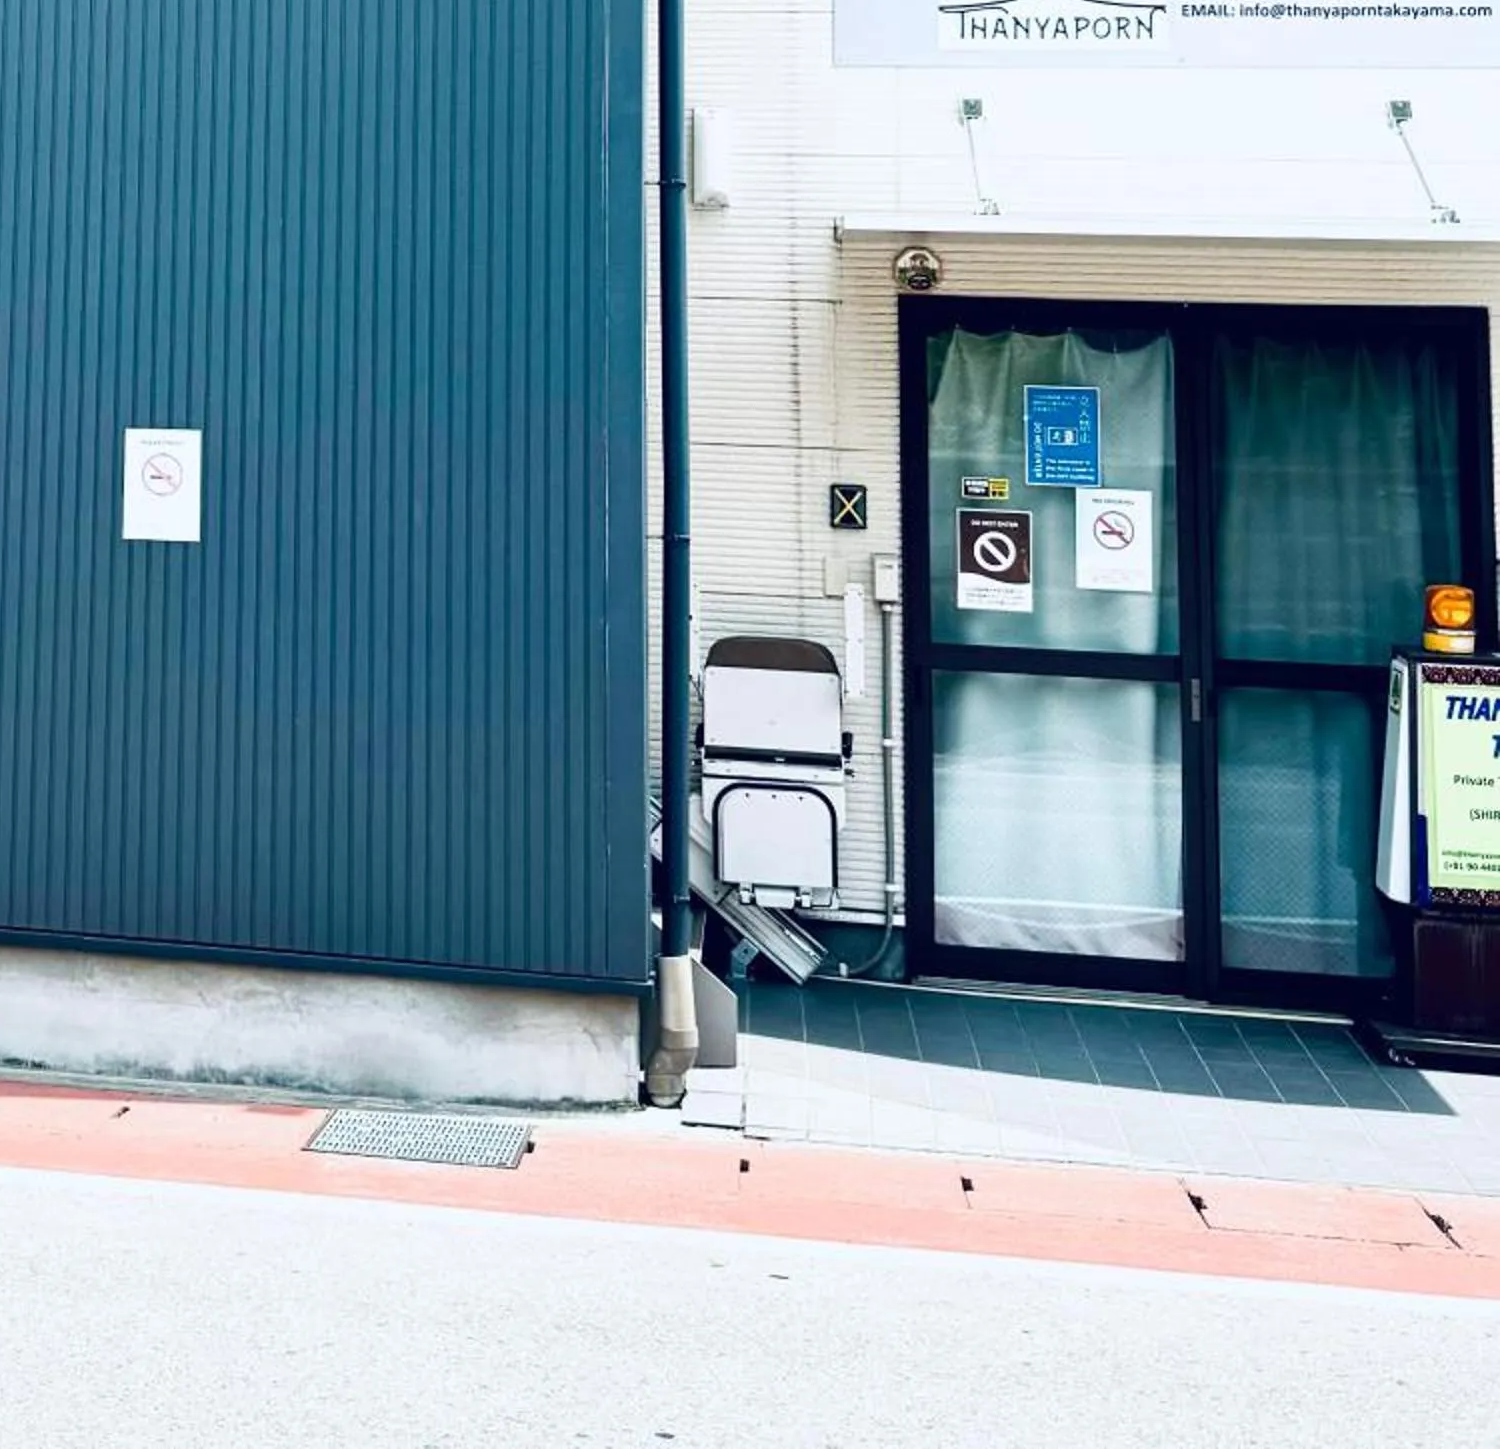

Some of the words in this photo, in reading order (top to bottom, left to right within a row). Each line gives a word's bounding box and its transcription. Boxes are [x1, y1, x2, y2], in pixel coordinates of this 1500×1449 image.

[1180, 4, 1235, 19] EMAIL:
[1238, 4, 1493, 21] info@thanyaporntakayama.com
[959, 7, 1155, 40] THANYAPORN
[1453, 774, 1495, 787] Private
